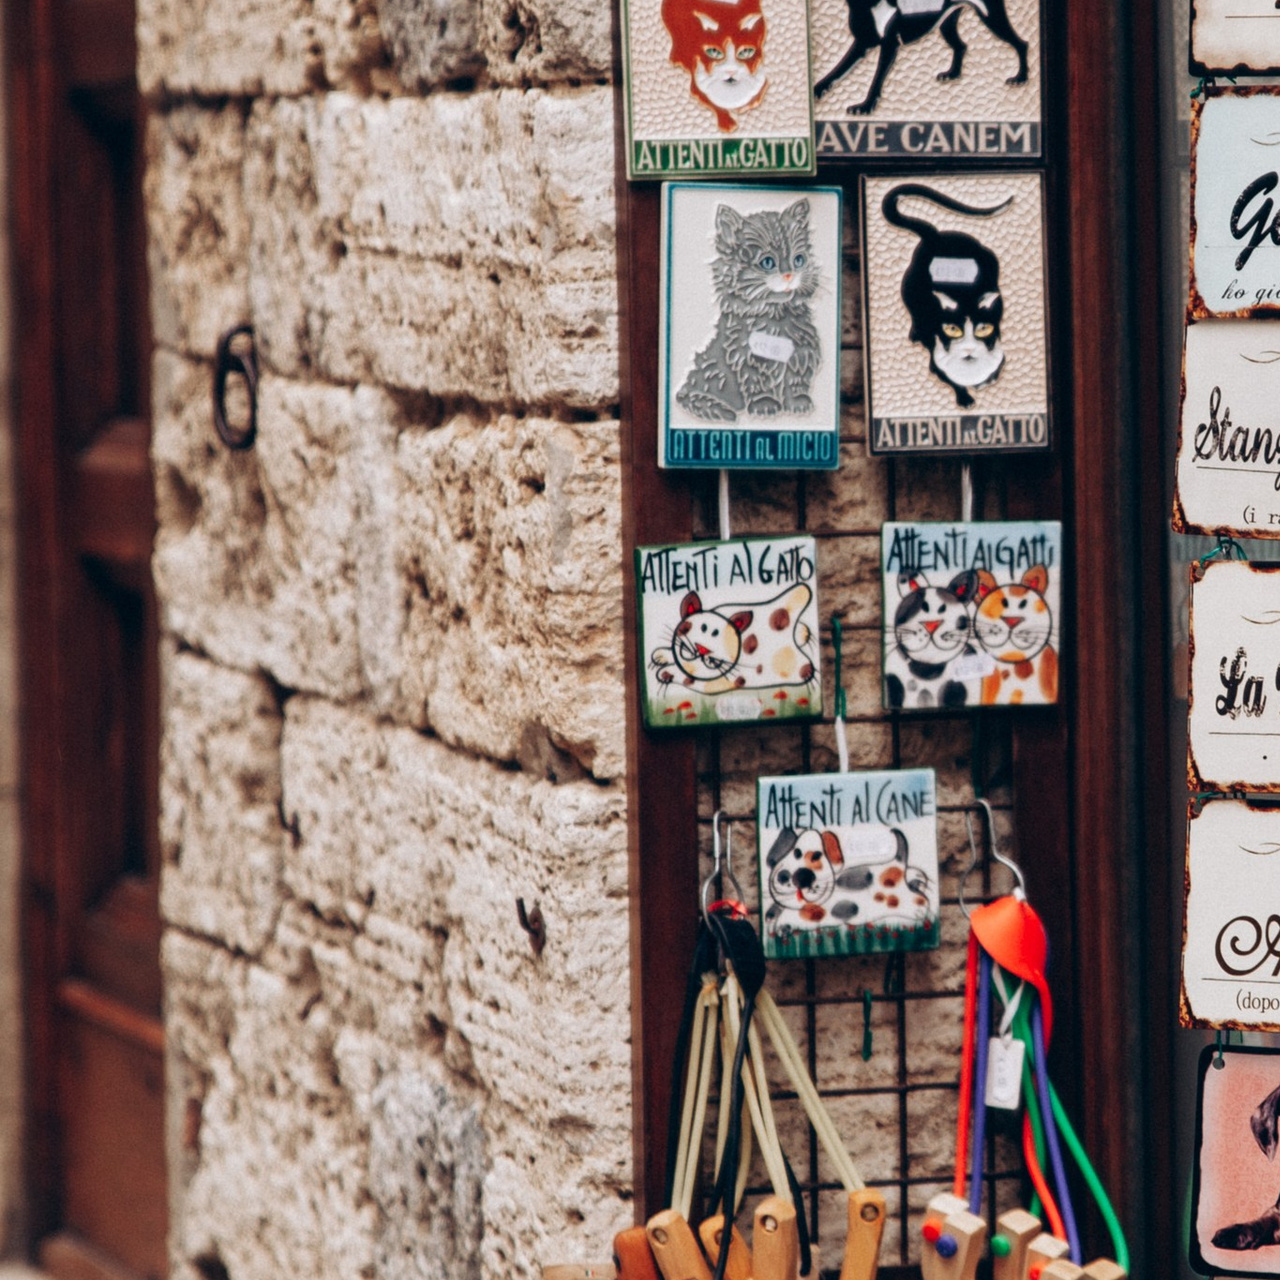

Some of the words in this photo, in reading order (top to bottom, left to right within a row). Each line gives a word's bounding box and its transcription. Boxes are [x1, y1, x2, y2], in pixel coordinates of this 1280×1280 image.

[816, 122, 890, 153] AVE
[900, 121, 1032, 153] CANEM
[637, 140, 724, 170] ATTENTI
[739, 138, 808, 168] GATTO
[1221, 278, 1246, 300] ho
[673, 431, 750, 461] ATTENTI
[778, 431, 832, 461] MICIO
[877, 419, 961, 448] ATTENTI
[977, 418, 1046, 446] GATTO
[1215, 645, 1266, 721] La
[876, 780, 934, 827] CANE
[1235, 989, 1280, 1013] (dopo
